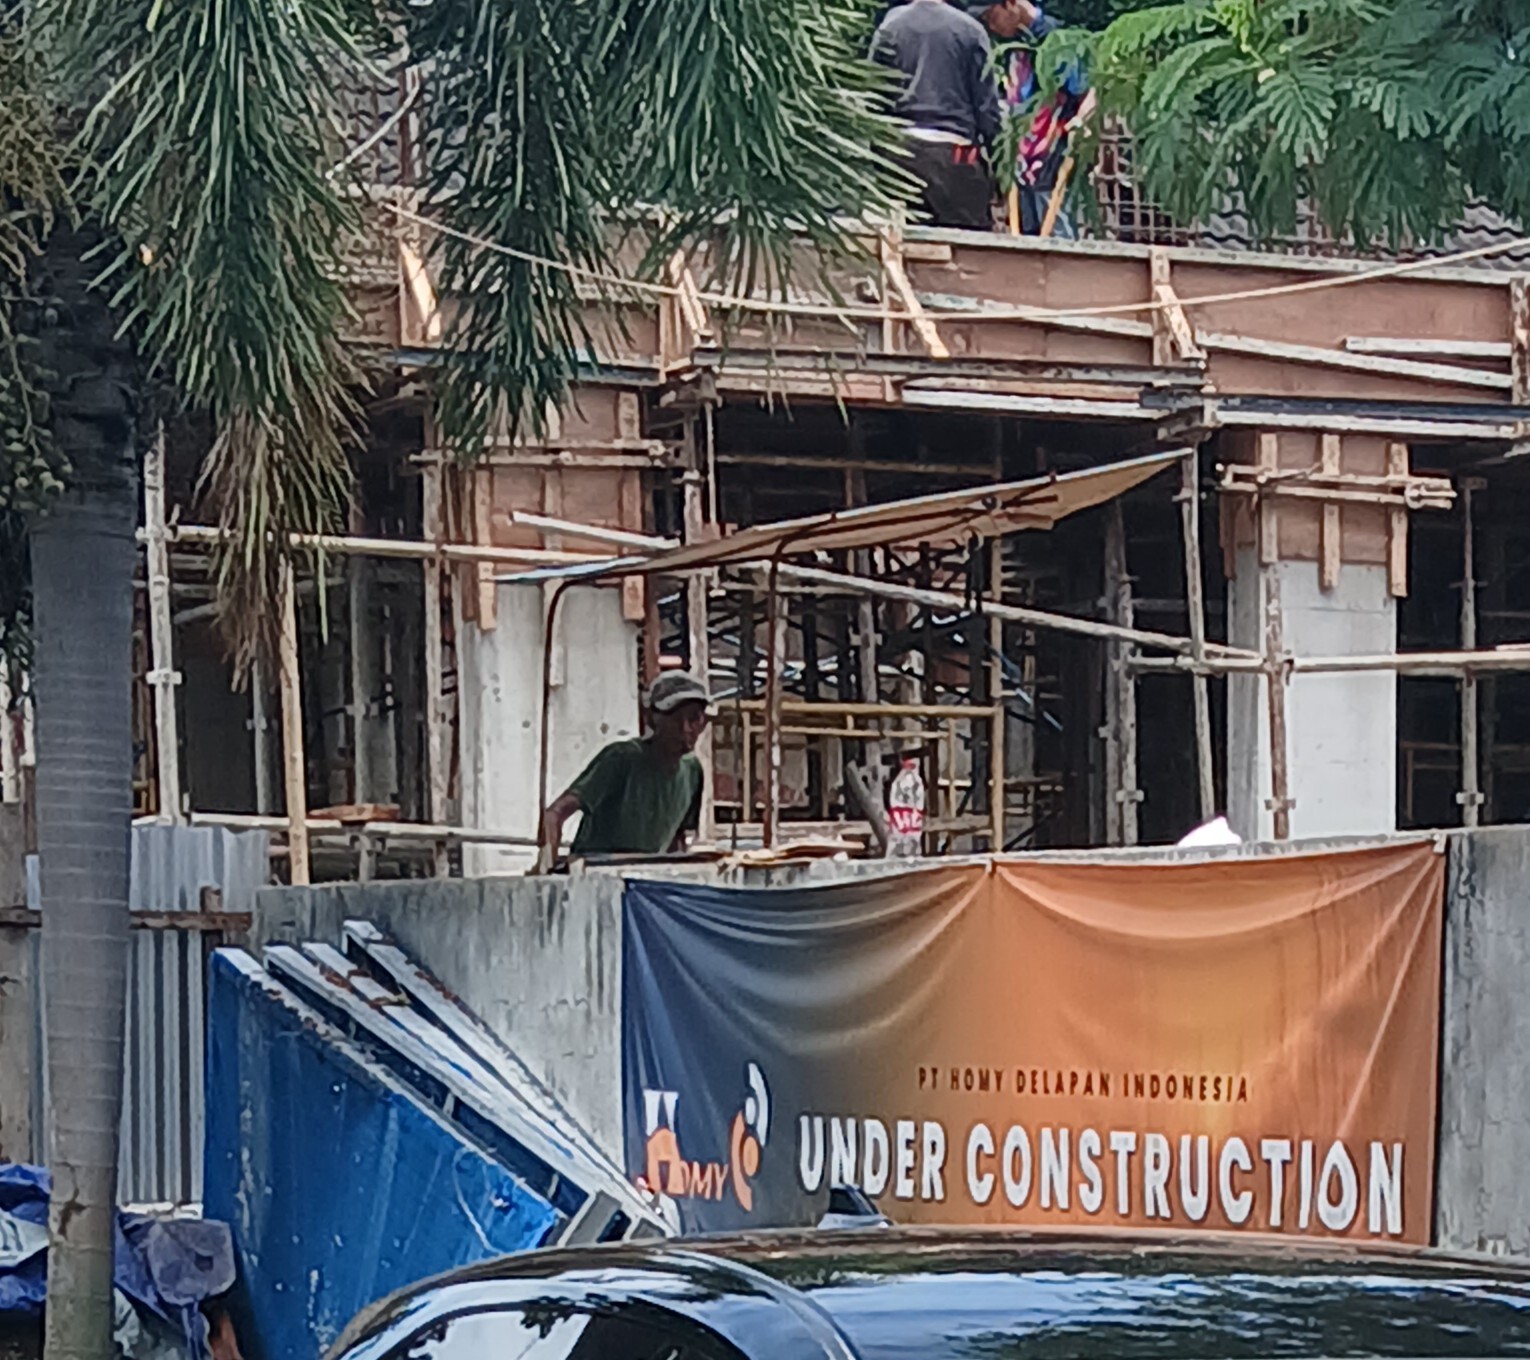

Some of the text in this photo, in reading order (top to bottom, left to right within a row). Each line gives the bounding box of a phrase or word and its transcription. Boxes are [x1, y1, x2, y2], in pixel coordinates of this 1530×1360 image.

[918, 1067, 1248, 1103] PT HOMY DELAPAN INDONESIA
[800, 1115, 1403, 1235] UNDER CONSTRUCTION
